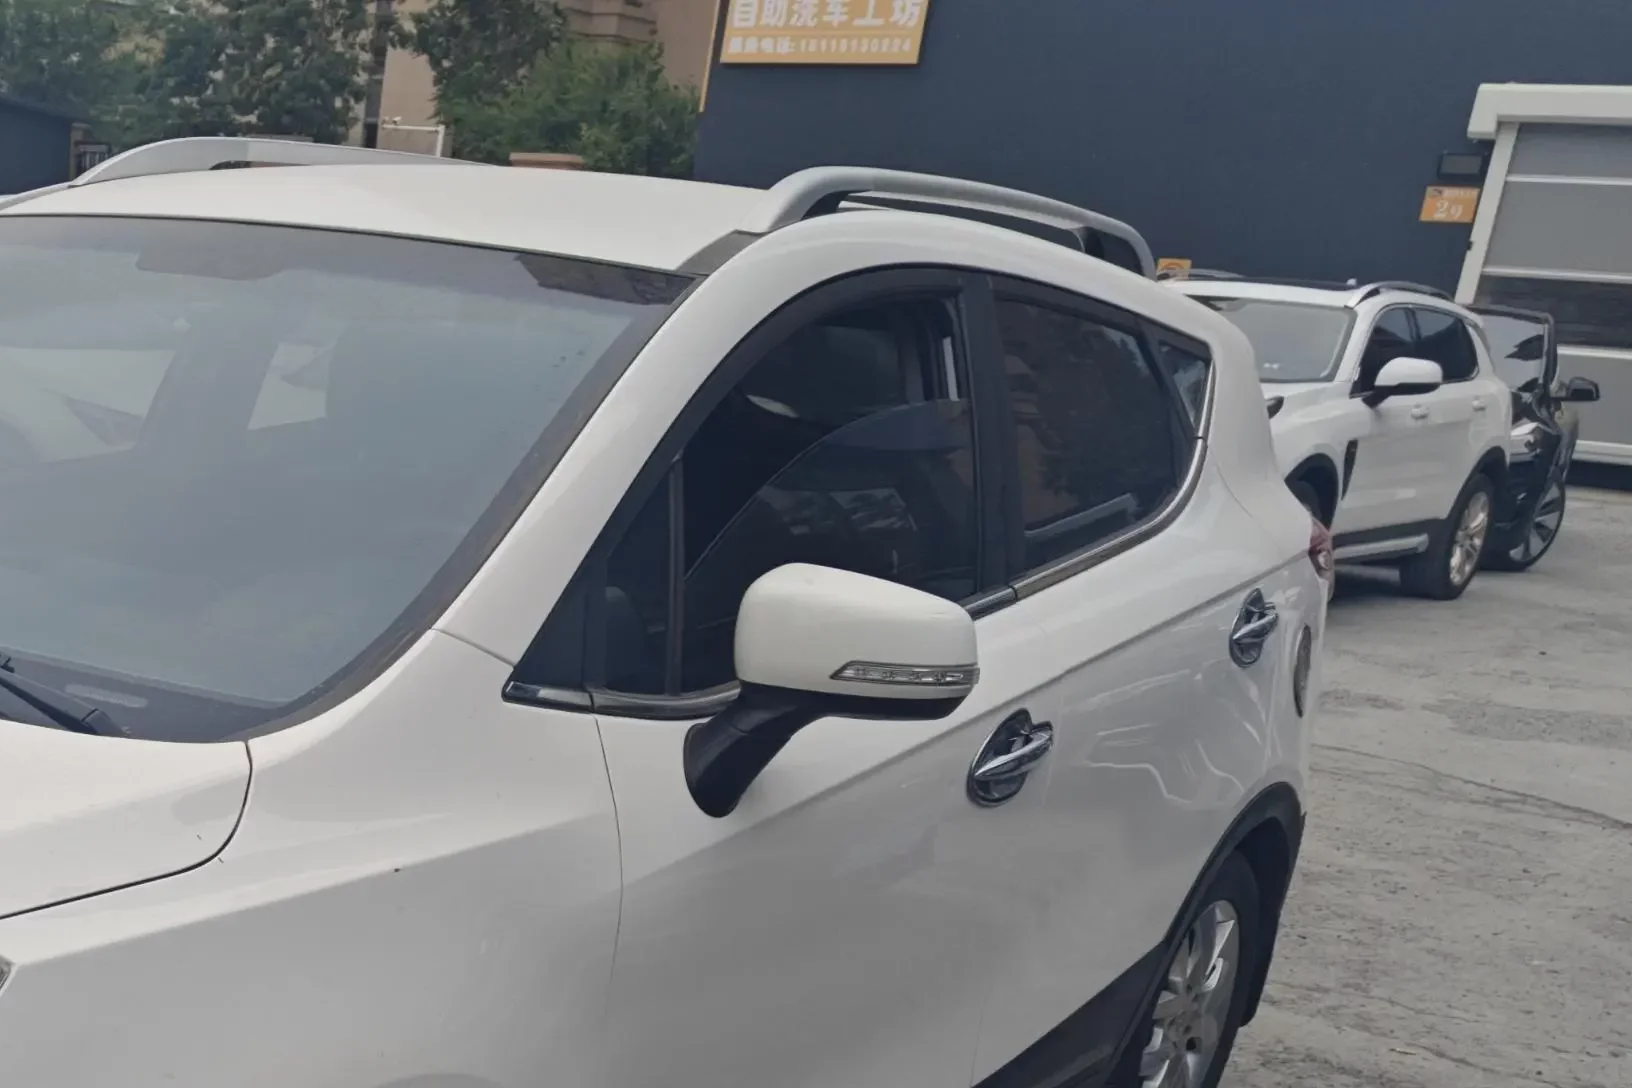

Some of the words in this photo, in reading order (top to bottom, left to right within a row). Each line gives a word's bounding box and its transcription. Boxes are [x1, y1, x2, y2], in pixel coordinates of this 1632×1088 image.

[732, 0, 921, 27] 自助洗车工坊
